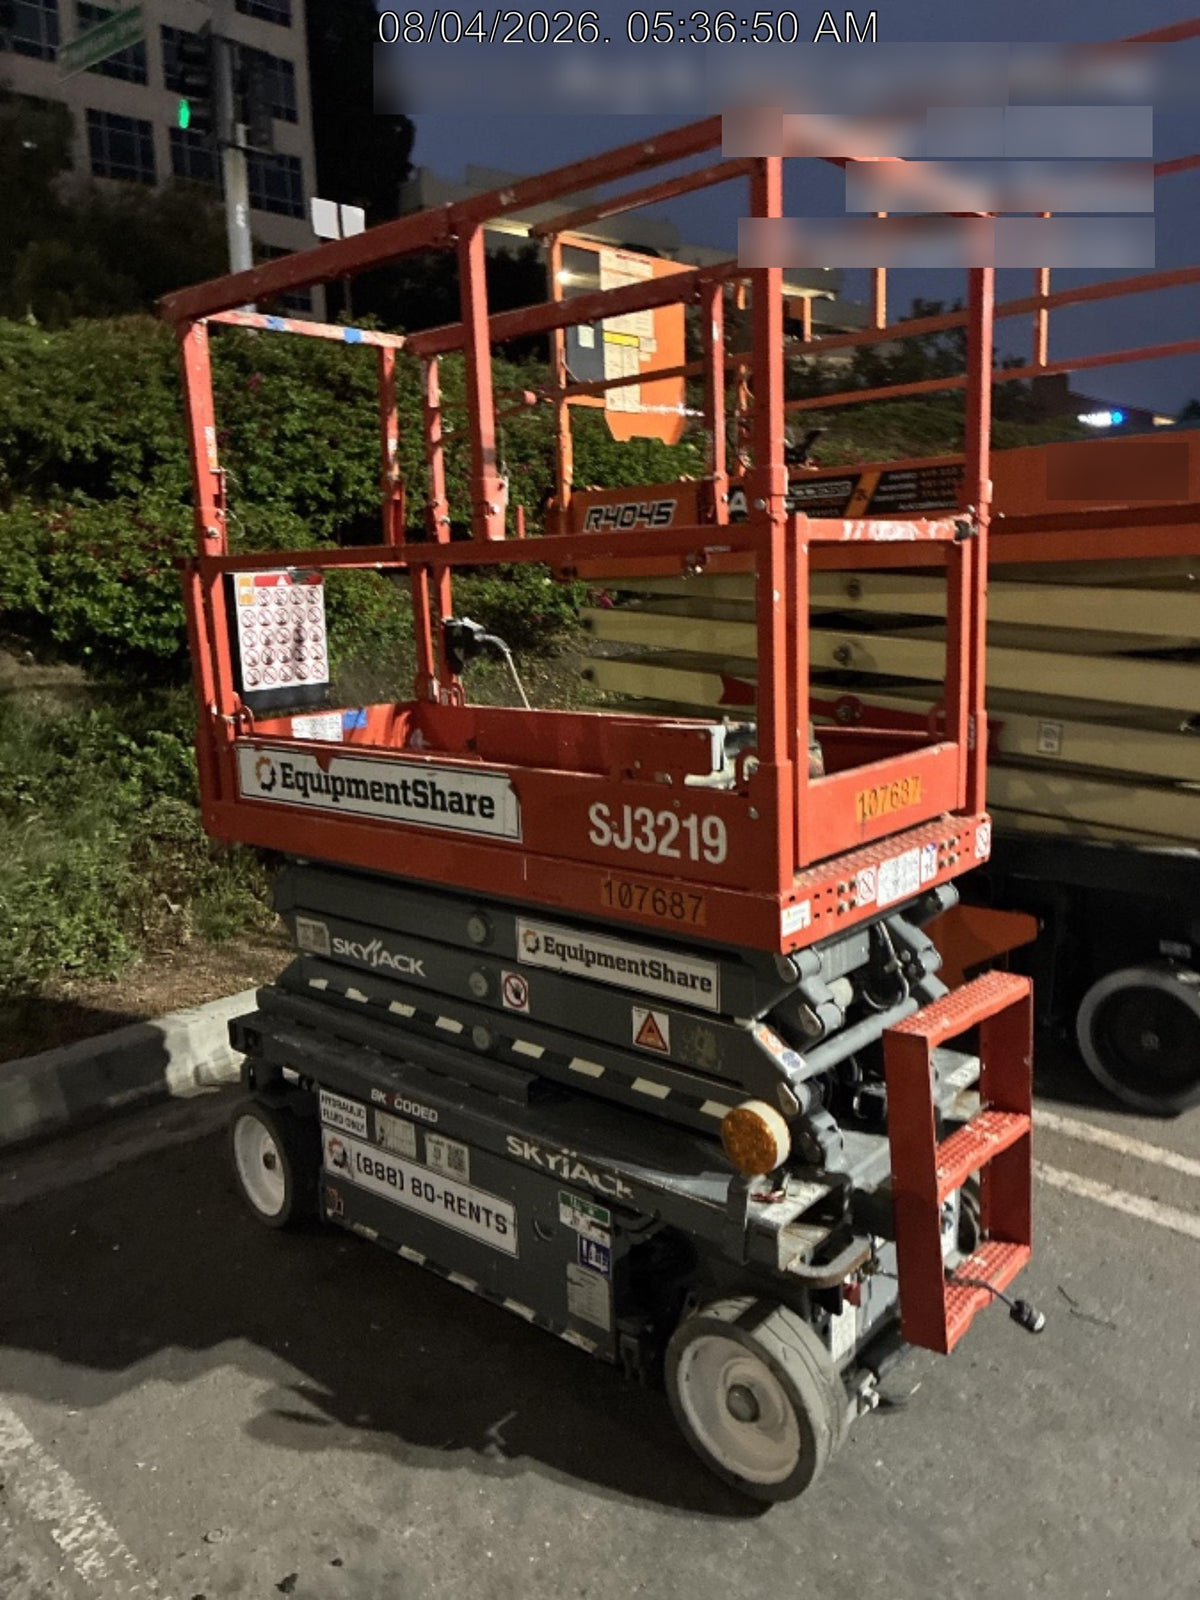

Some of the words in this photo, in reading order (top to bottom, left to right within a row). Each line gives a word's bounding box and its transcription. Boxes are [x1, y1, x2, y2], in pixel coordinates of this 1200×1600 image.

[584, 499, 677, 533] R4045
[280, 762, 496, 819] EquipmentShare
[588, 802, 728, 865] SJ3219
[604, 880, 704, 924] 107687
[332, 937, 427, 977] SKYJACK
[543, 935, 713, 993] EquipmentShare
[356, 1152, 405, 1190] (888)
[411, 1177, 509, 1235] 80-RENTS
